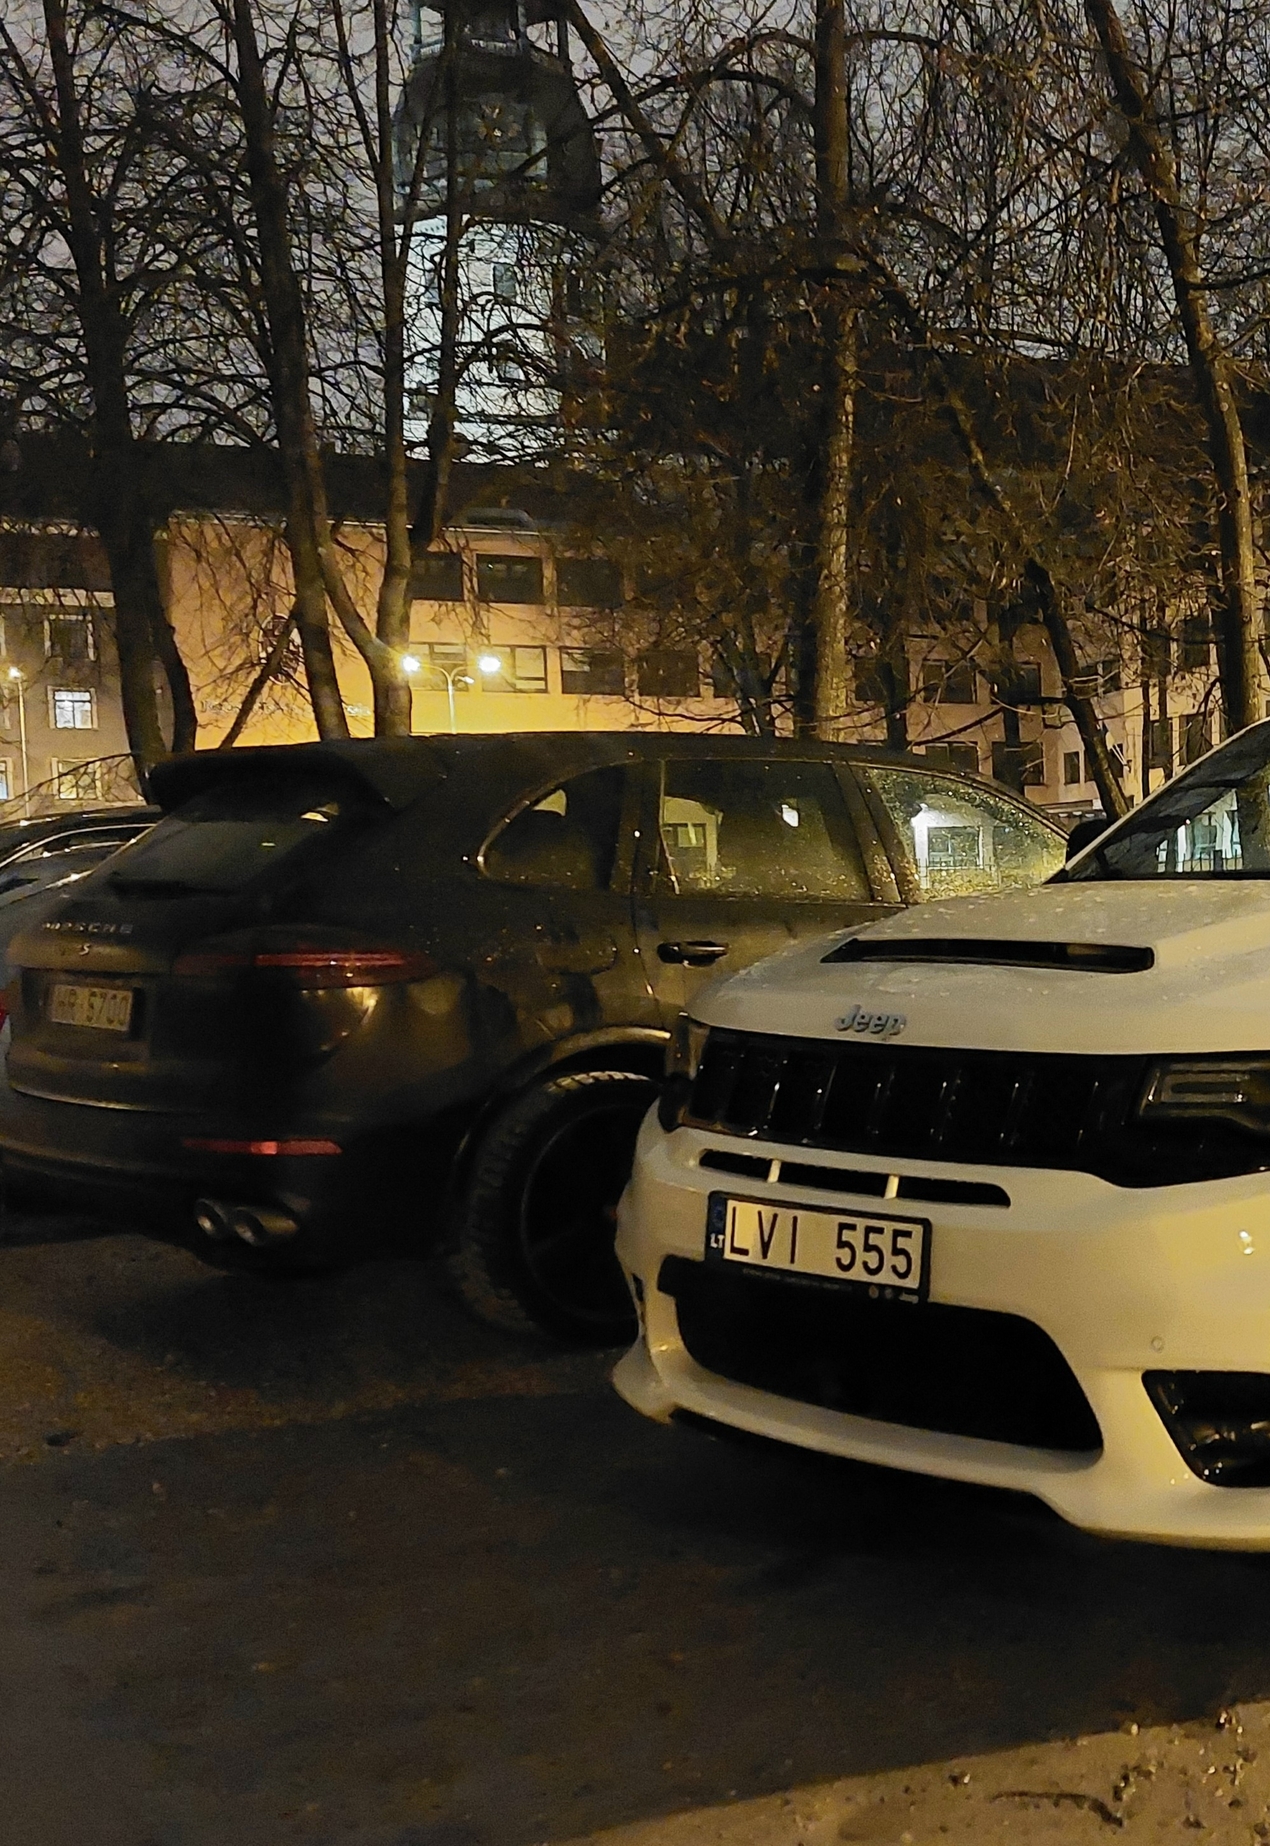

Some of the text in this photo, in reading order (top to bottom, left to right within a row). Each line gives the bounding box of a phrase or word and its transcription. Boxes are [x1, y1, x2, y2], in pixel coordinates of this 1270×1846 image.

[834, 1004, 906, 1035] Jeep
[710, 1233, 724, 1248] LT
[730, 1206, 913, 1279] LVI 555
